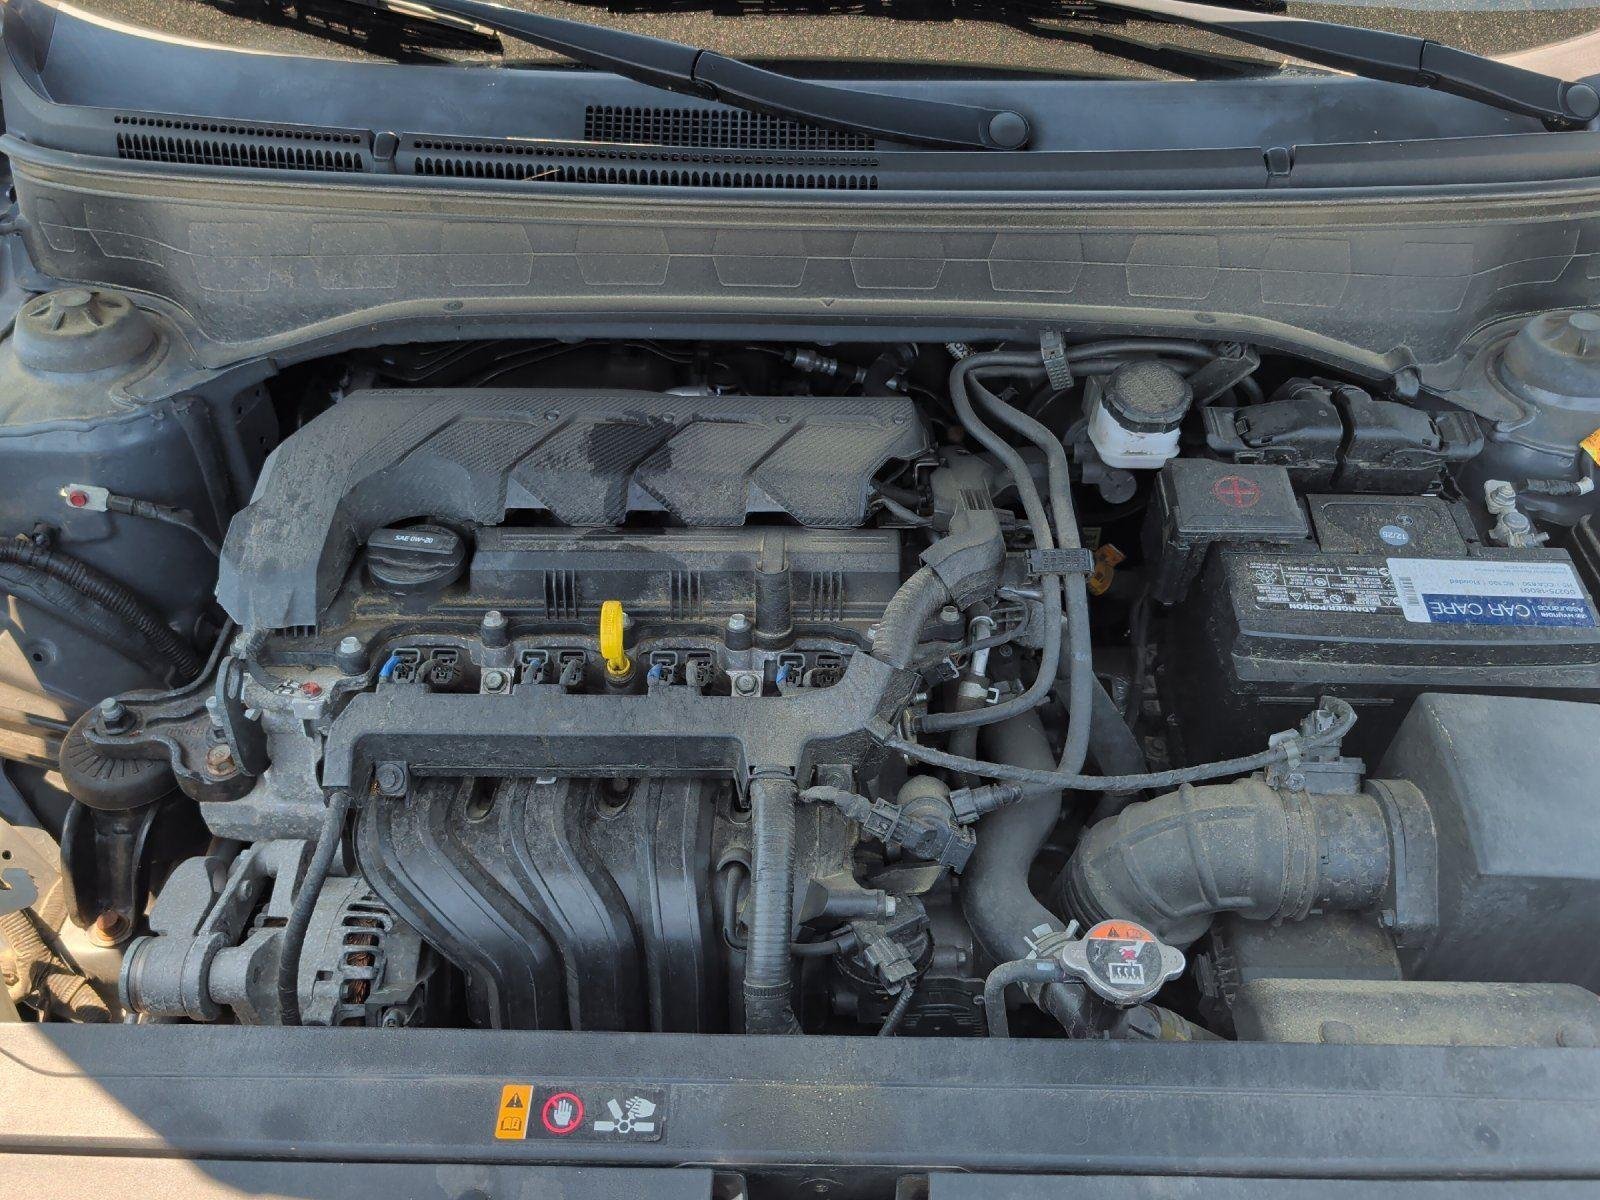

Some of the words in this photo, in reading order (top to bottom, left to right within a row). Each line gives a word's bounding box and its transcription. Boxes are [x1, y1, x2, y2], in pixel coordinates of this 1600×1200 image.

[410, 536, 434, 544] 0W-20
[1428, 601, 1483, 615] CARE
[1487, 603, 1531, 617] CAR
[1537, 604, 1584, 613] Assurance
